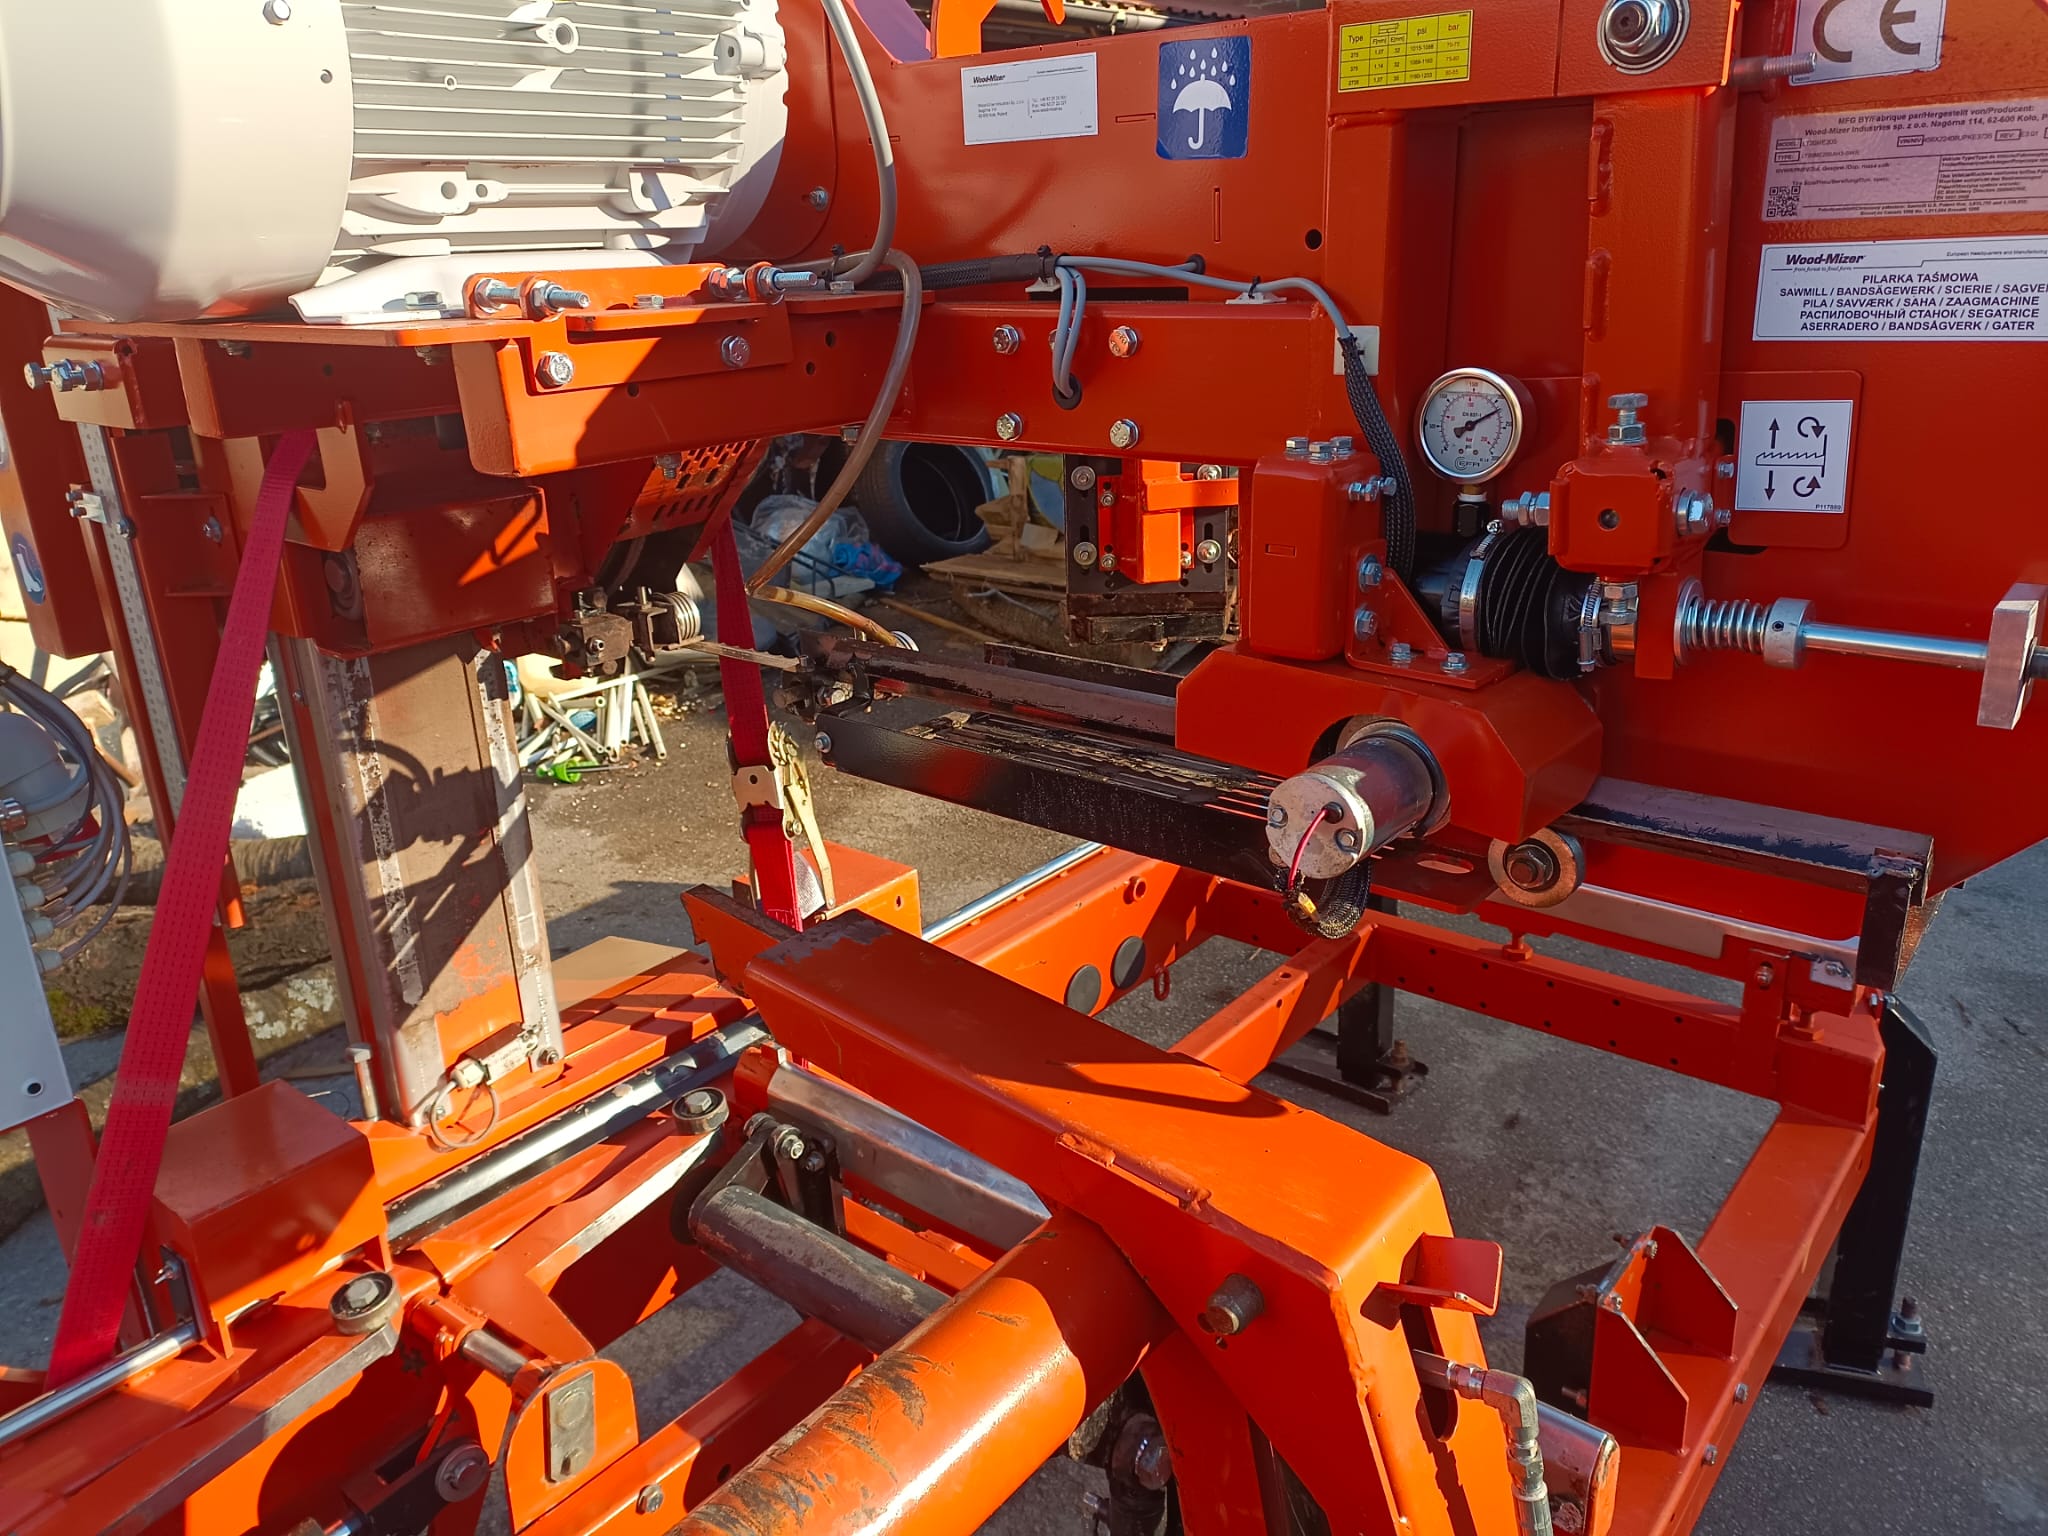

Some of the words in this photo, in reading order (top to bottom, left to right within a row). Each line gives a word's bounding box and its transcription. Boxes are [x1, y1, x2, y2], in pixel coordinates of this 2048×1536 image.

[1416, 26, 1428, 36] psi
[1447, 23, 1460, 31] bar
[1348, 34, 1364, 45] Type
[972, 74, 1006, 84] Wood-Mizer
[1837, 116, 1856, 125] MFG
[1970, 104, 2035, 116] von/Producent:
[1804, 126, 1851, 136] Wood-Mizer
[1851, 123, 1892, 133] Industries
[1786, 252, 1865, 266] Wood-Mizer
[1862, 273, 1914, 284] PILARKA
[1916, 271, 1979, 283] TAŚMOWA
[1779, 286, 1829, 297] SAWMILL
[1836, 284, 1936, 296] BANDSÄGEWERK
[1944, 284, 1993, 294] SCIERIE
[1802, 298, 1828, 308] PILA
[1836, 298, 1894, 308] SAVVÆRK
[1903, 296, 1937, 307] SAHA
[1945, 296, 2040, 307] ZAAGMACHINE
[1799, 308, 1906, 320] РАСПИЛОВОЧНЫЙ
[1908, 308, 1959, 319] СТАНОК
[1967, 308, 2040, 318] SEGATRICE
[1800, 321, 1879, 331] ASERRADERO
[1888, 320, 1982, 331] BANDSÅGVERK
[1992, 320, 2036, 331] GATER
